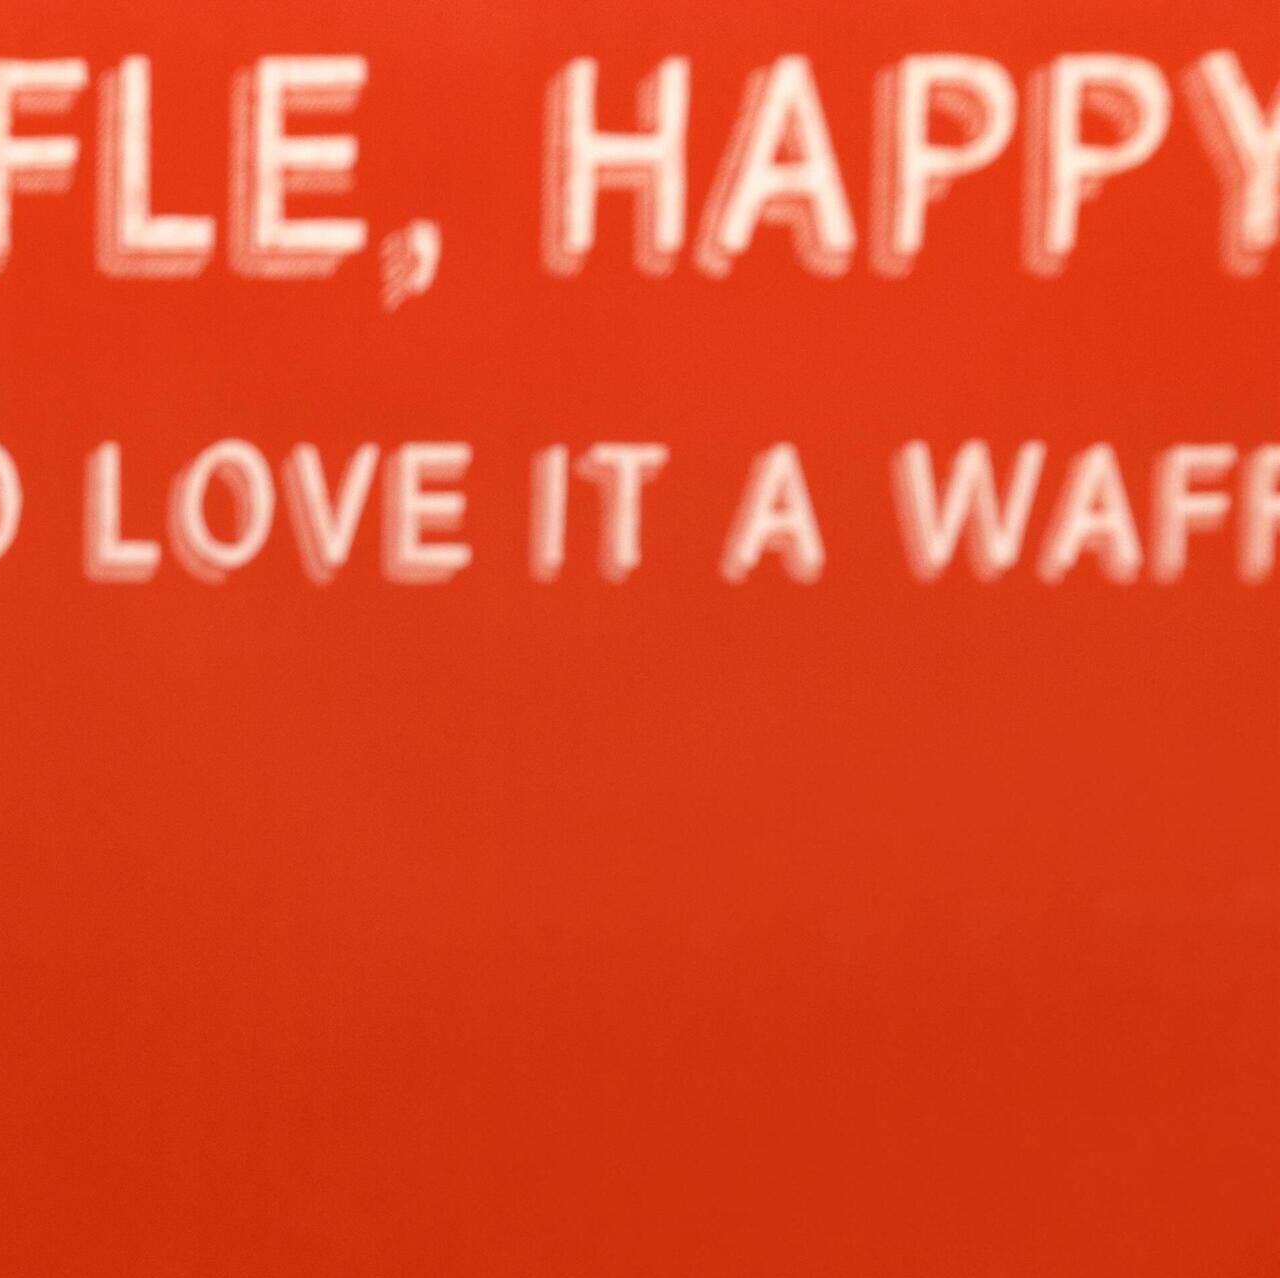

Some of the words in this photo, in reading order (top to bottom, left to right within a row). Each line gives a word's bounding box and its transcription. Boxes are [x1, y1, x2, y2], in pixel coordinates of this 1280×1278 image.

[82, 440, 473, 586] LOVE
[528, 442, 670, 584] IT
[720, 441, 826, 586] A
